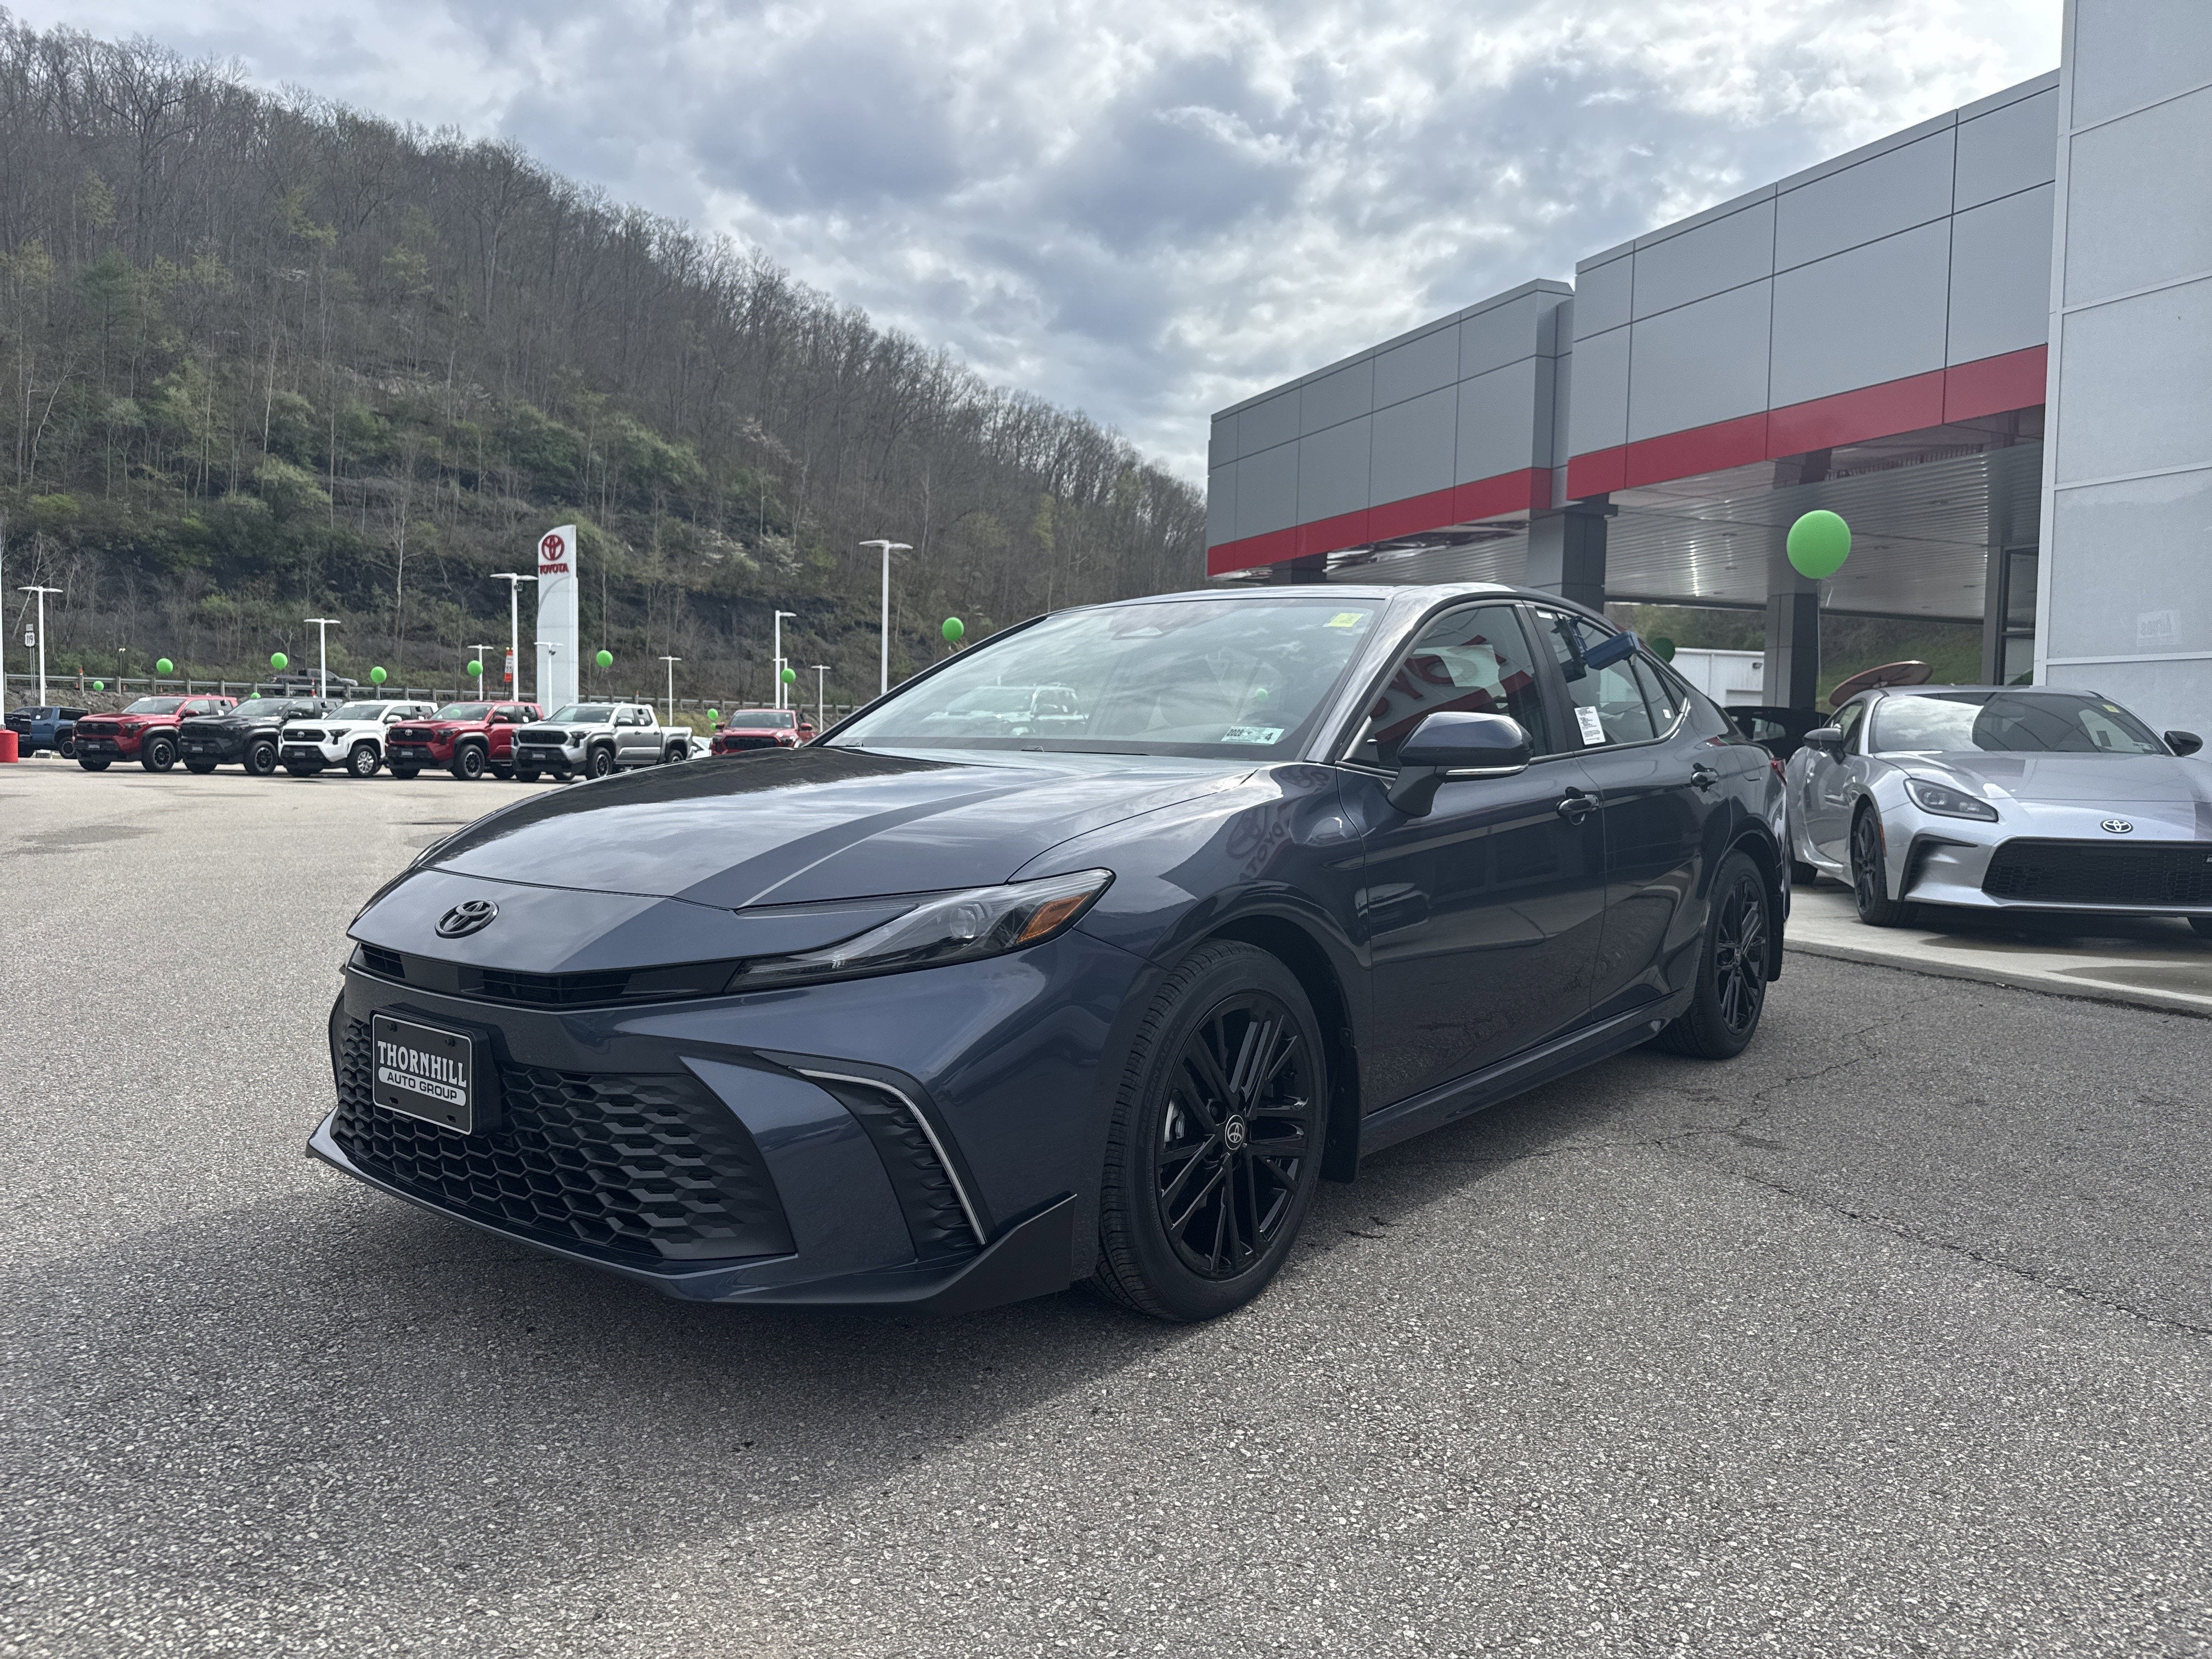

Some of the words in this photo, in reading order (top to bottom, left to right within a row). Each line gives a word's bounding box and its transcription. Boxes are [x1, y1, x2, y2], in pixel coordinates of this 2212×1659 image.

[539, 563, 569, 575] TOYOTA
[377, 1041, 466, 1087] THORNHILL
[387, 1071, 415, 1088] AUTO
[420, 1081, 457, 1100] GROUP
